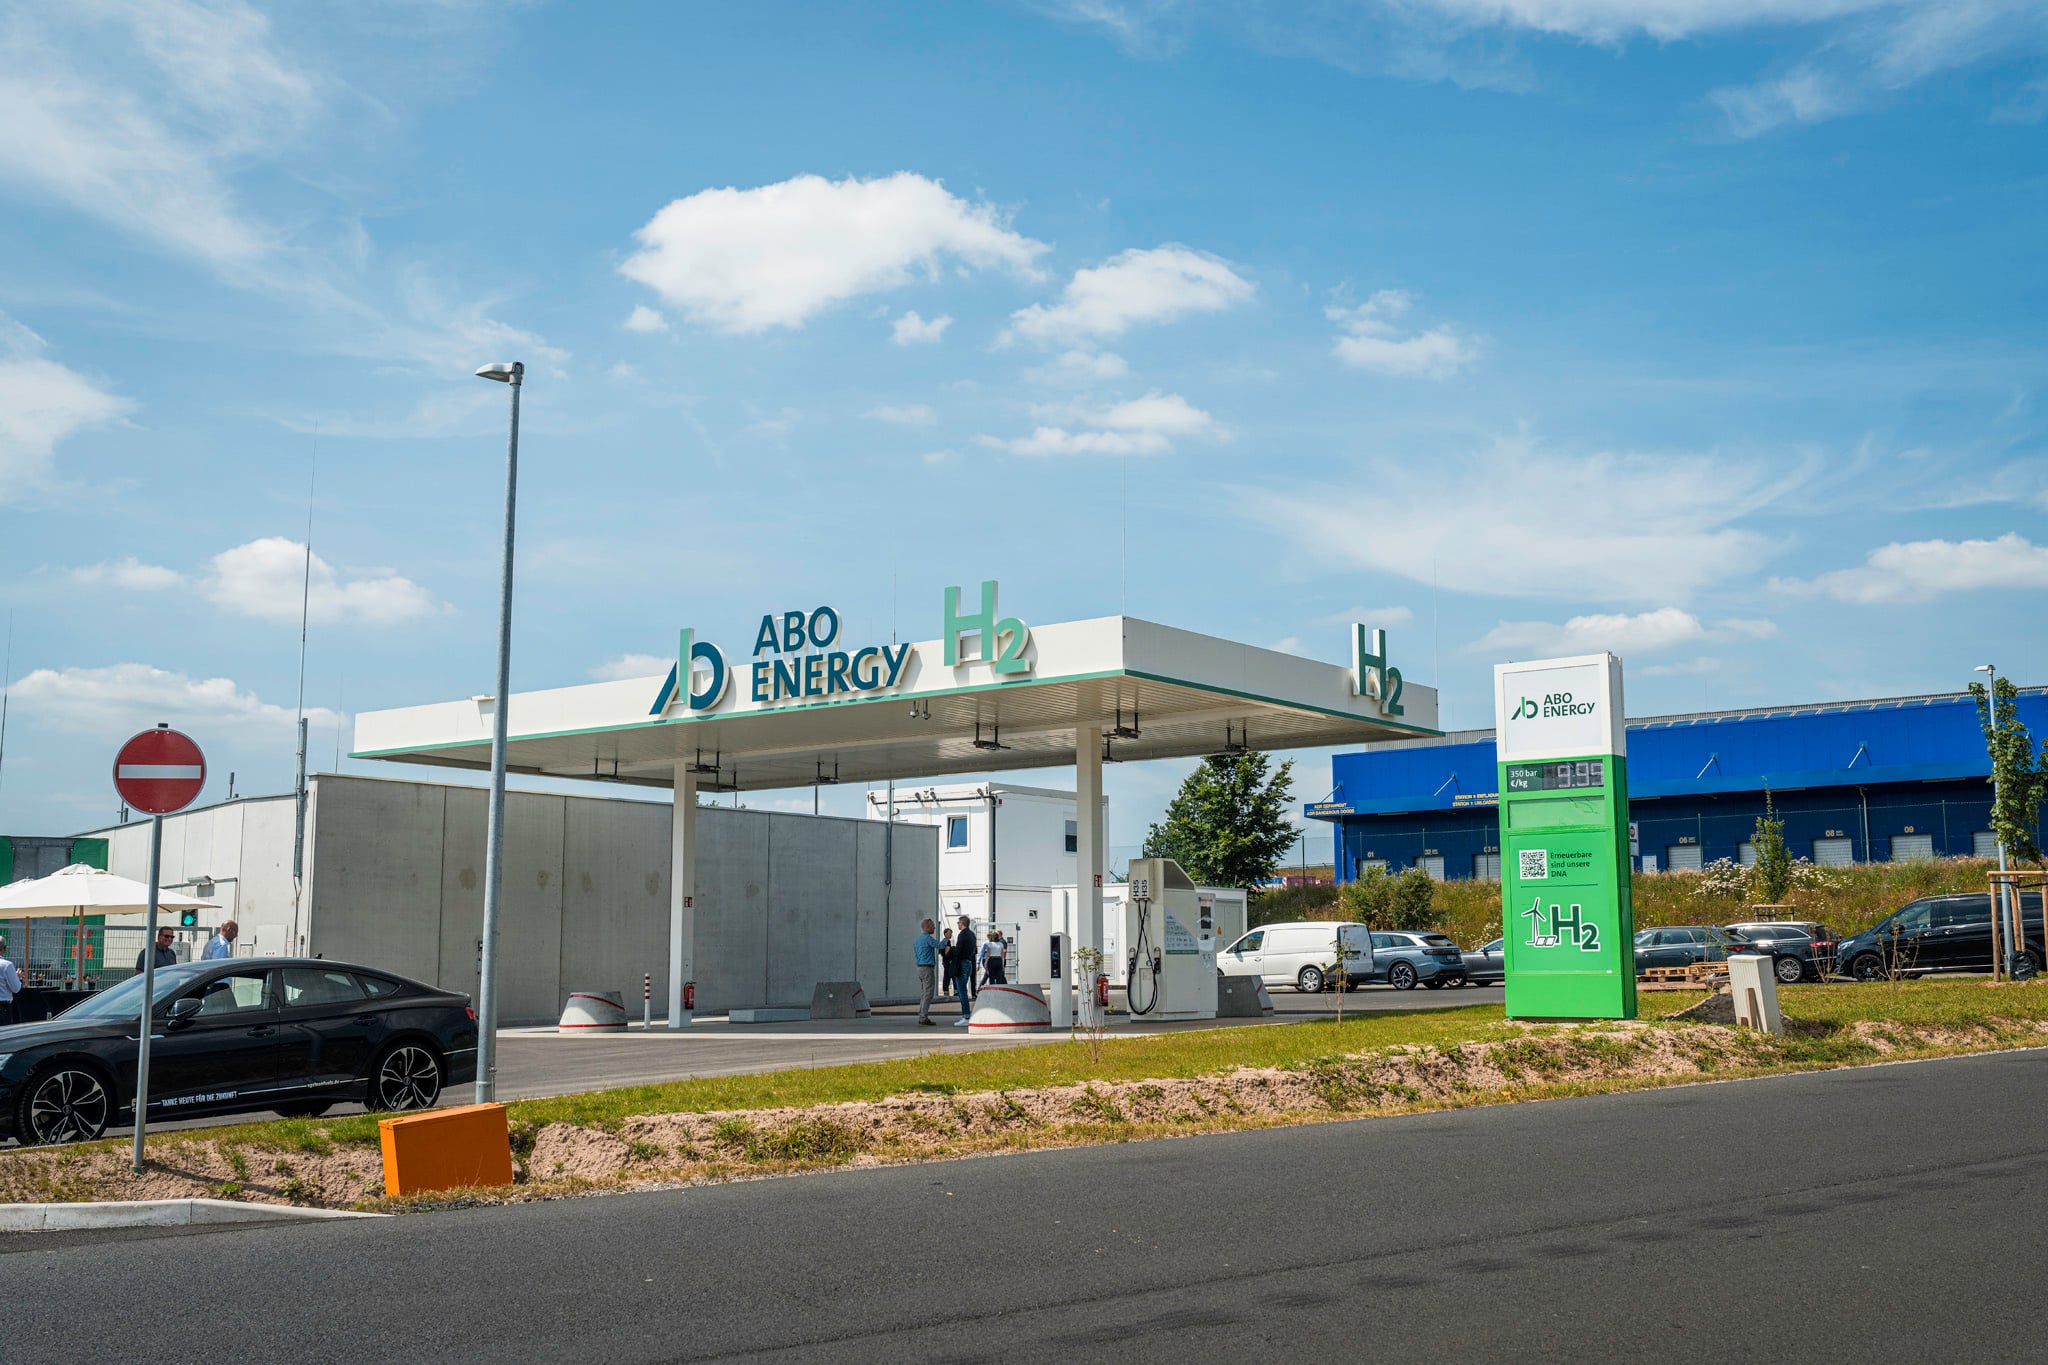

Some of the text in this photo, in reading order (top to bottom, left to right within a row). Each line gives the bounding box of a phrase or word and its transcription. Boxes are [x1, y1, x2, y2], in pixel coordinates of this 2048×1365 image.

[752, 606, 841, 656] ABO
[944, 580, 1029, 674] H2
[752, 643, 911, 702] ENERGY
[1353, 623, 1404, 716] H2
[1543, 702, 1595, 718] ENERGY
[1544, 692, 1572, 705] ABO
[1510, 769, 1538, 778] 350 bar
[1510, 779, 1528, 788] €/kg
[1550, 851, 1593, 859] Erneuerbare
[1551, 905, 1600, 951] H2
